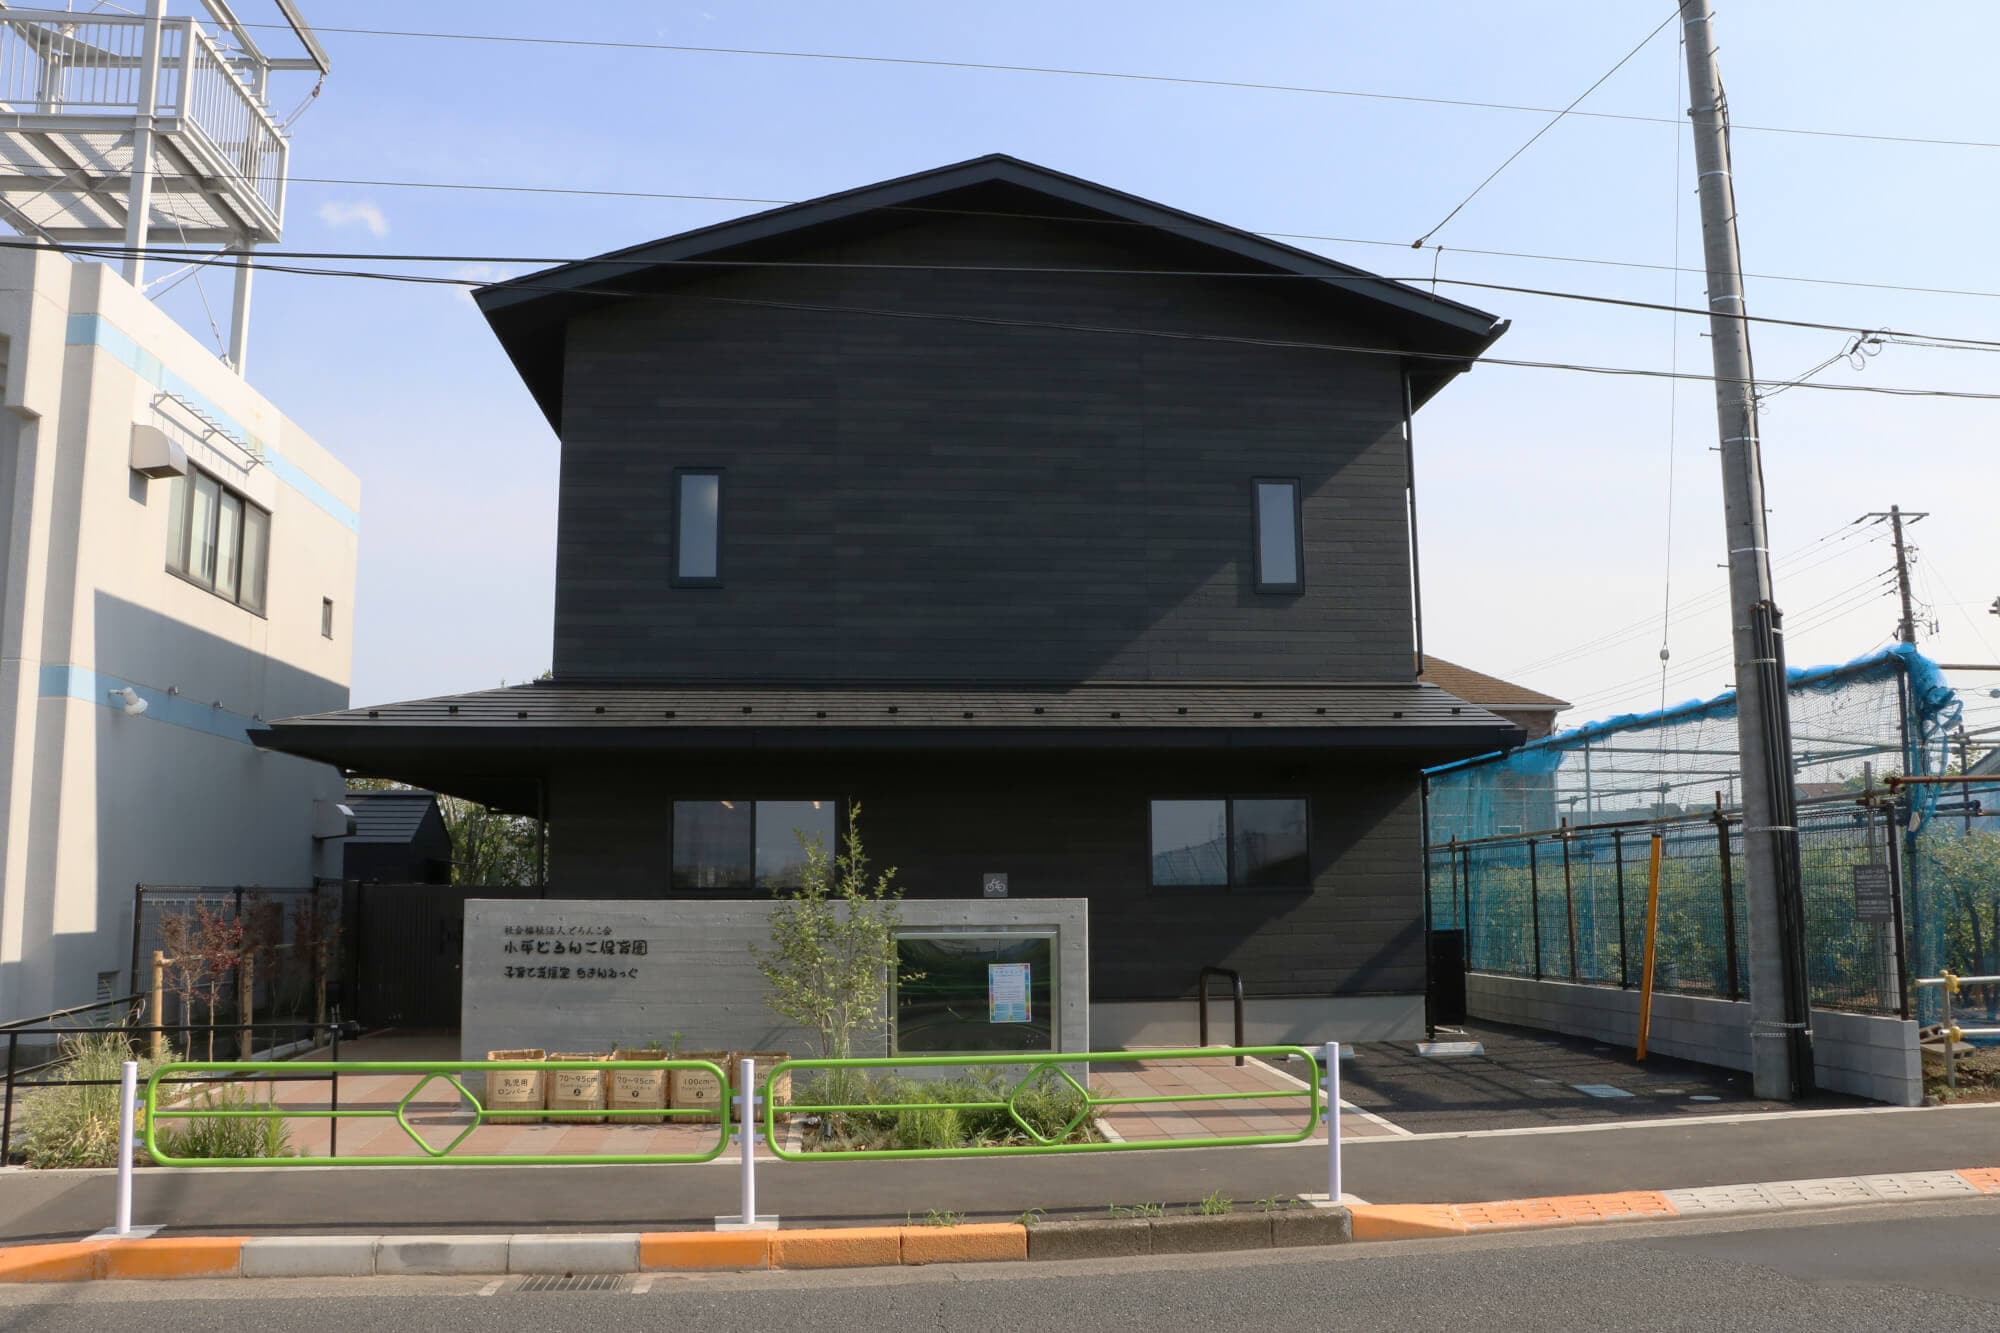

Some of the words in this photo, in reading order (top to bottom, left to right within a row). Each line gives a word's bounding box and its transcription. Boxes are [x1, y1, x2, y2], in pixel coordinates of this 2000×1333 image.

[504, 939, 648, 956] 小平どろんこ保育園
